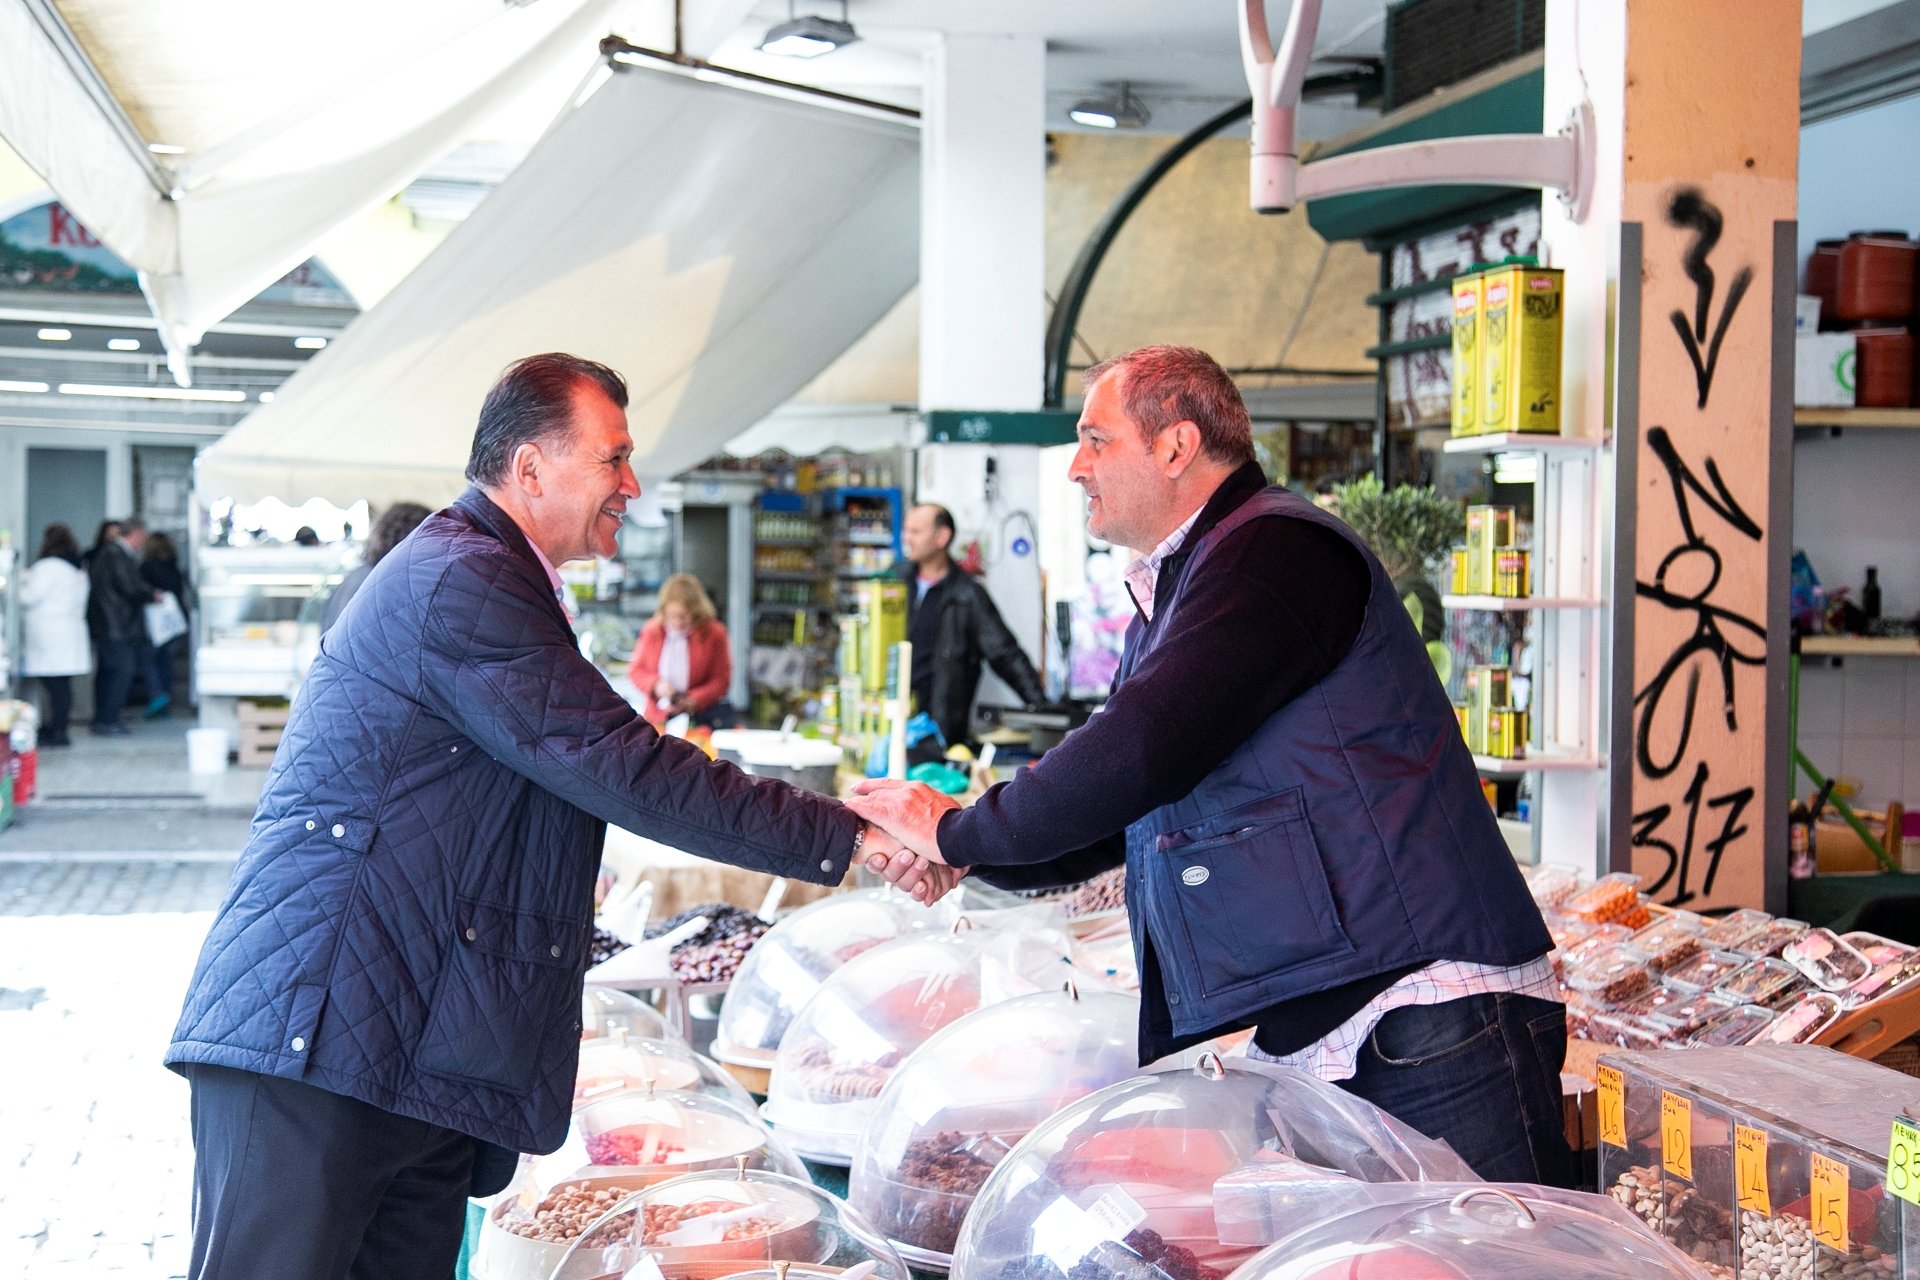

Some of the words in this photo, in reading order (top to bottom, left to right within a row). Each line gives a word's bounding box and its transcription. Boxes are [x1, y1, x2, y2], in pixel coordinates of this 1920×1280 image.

[1632, 761, 1754, 908] 317
[1602, 1099, 1618, 1138] 16
[1665, 1127, 1686, 1172] 12
[1738, 1158, 1764, 1201] 14
[1815, 1192, 1843, 1241] 15
